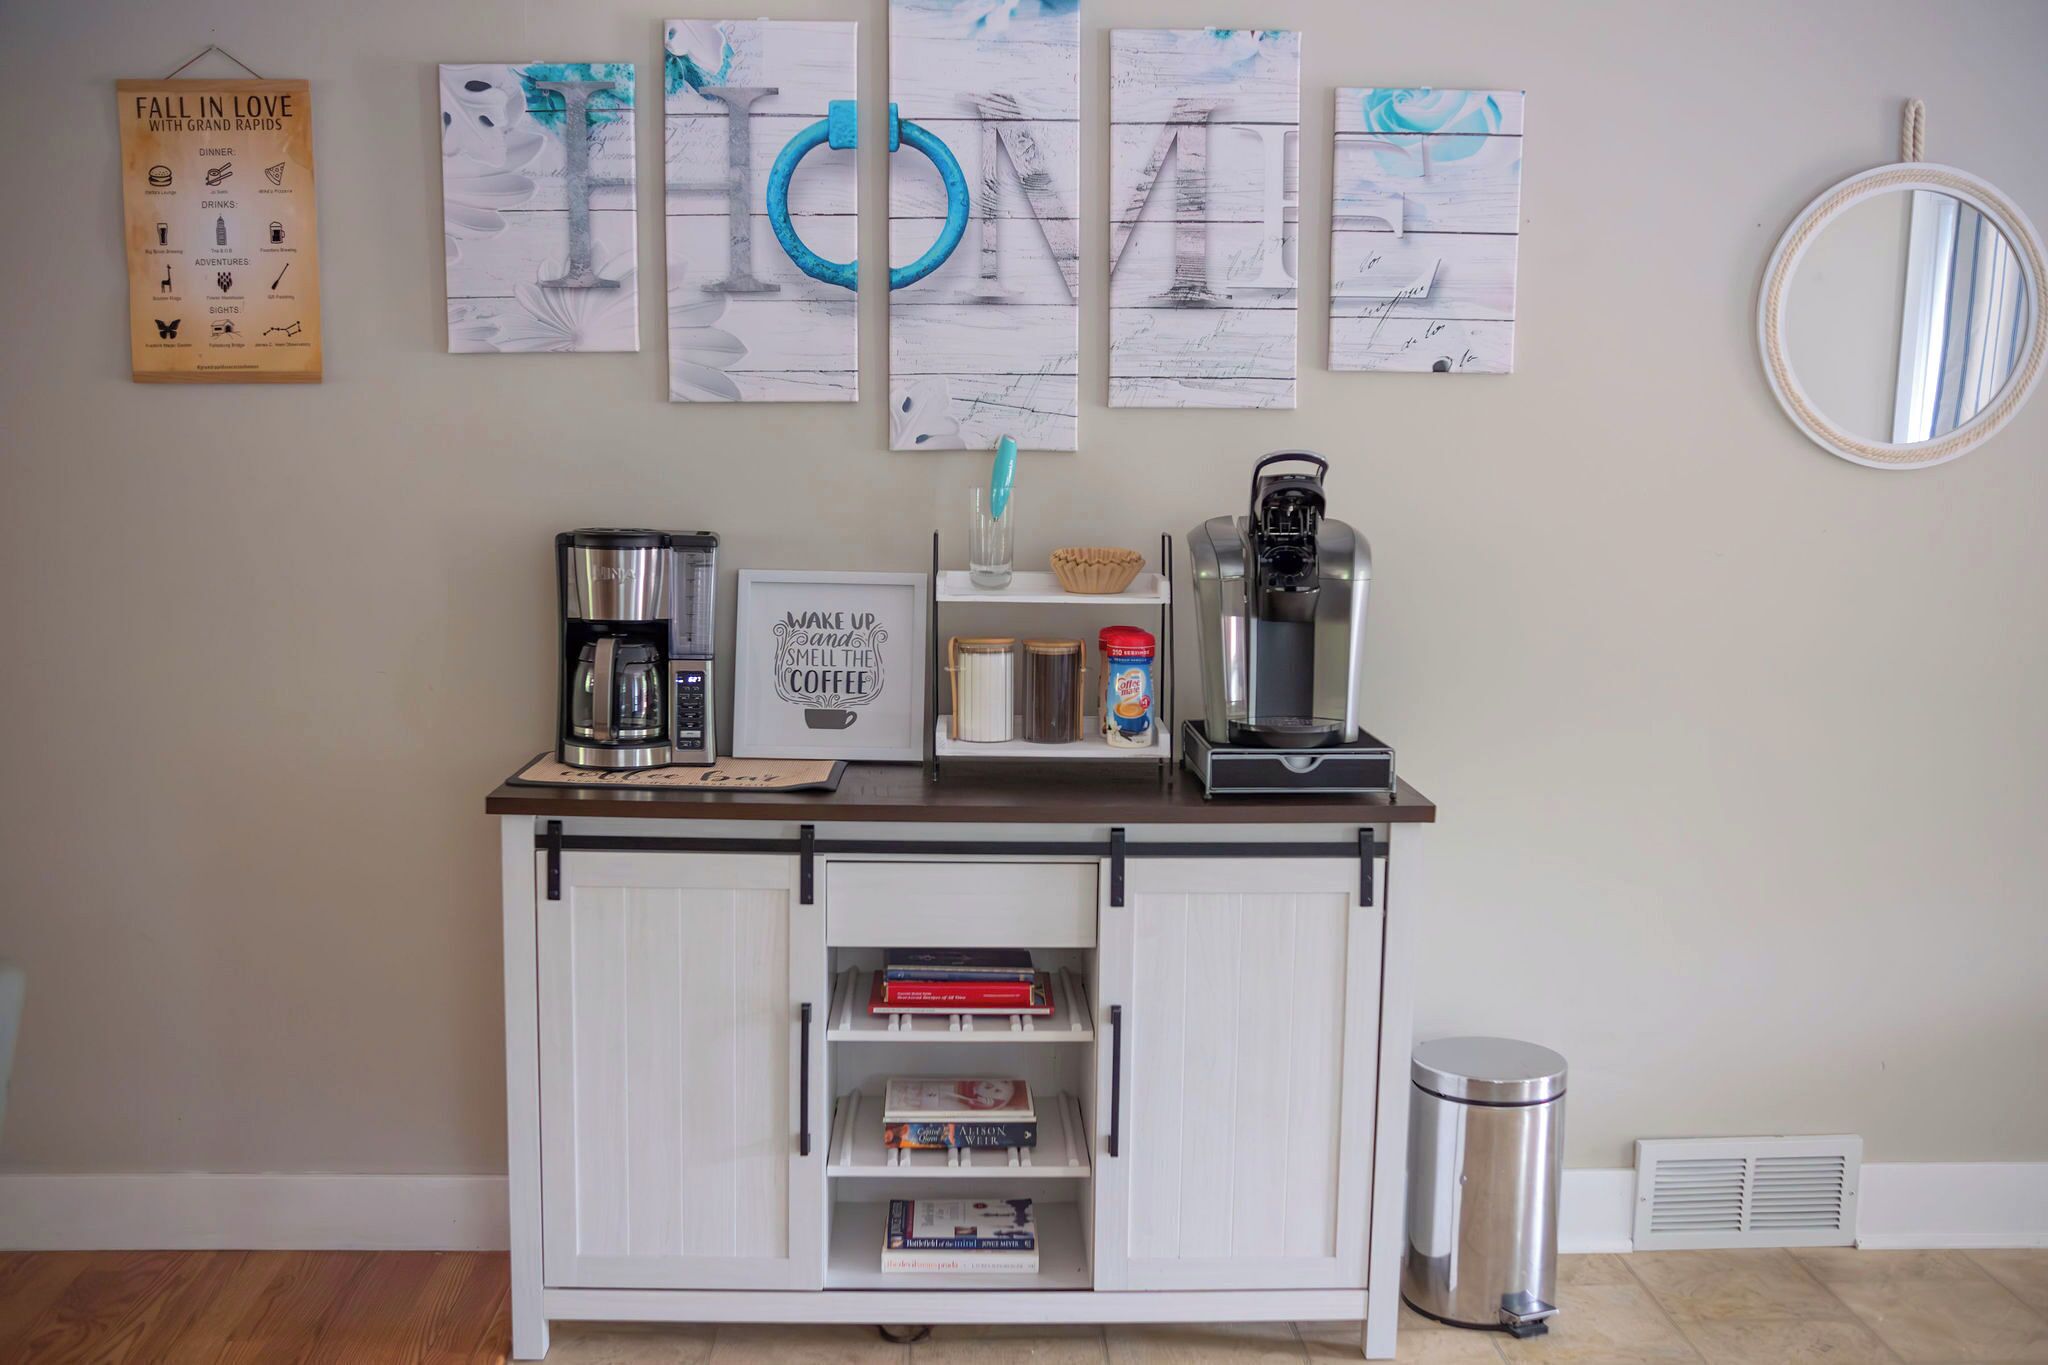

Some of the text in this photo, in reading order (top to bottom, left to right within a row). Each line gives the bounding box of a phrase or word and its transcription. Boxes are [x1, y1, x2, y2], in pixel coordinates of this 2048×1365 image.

[136, 94, 293, 119] FALL IN LOVE
[149, 118, 283, 132] WITH GRAND RAPIDS
[199, 147, 236, 157] DINNER:
[533, 80, 1442, 304] HOME
[201, 200, 238, 209] DRINKS:
[195, 258, 251, 267] ADVENTURES:
[787, 611, 875, 630] WAKE UP
[810, 631, 854, 648] and
[786, 648, 873, 667] SMELL THE
[790, 669, 869, 694] COFFEE
[959, 1125, 1007, 1136] ALISON
[965, 1135, 999, 1145] WEIR
[955, 1239, 977, 1248] mind
